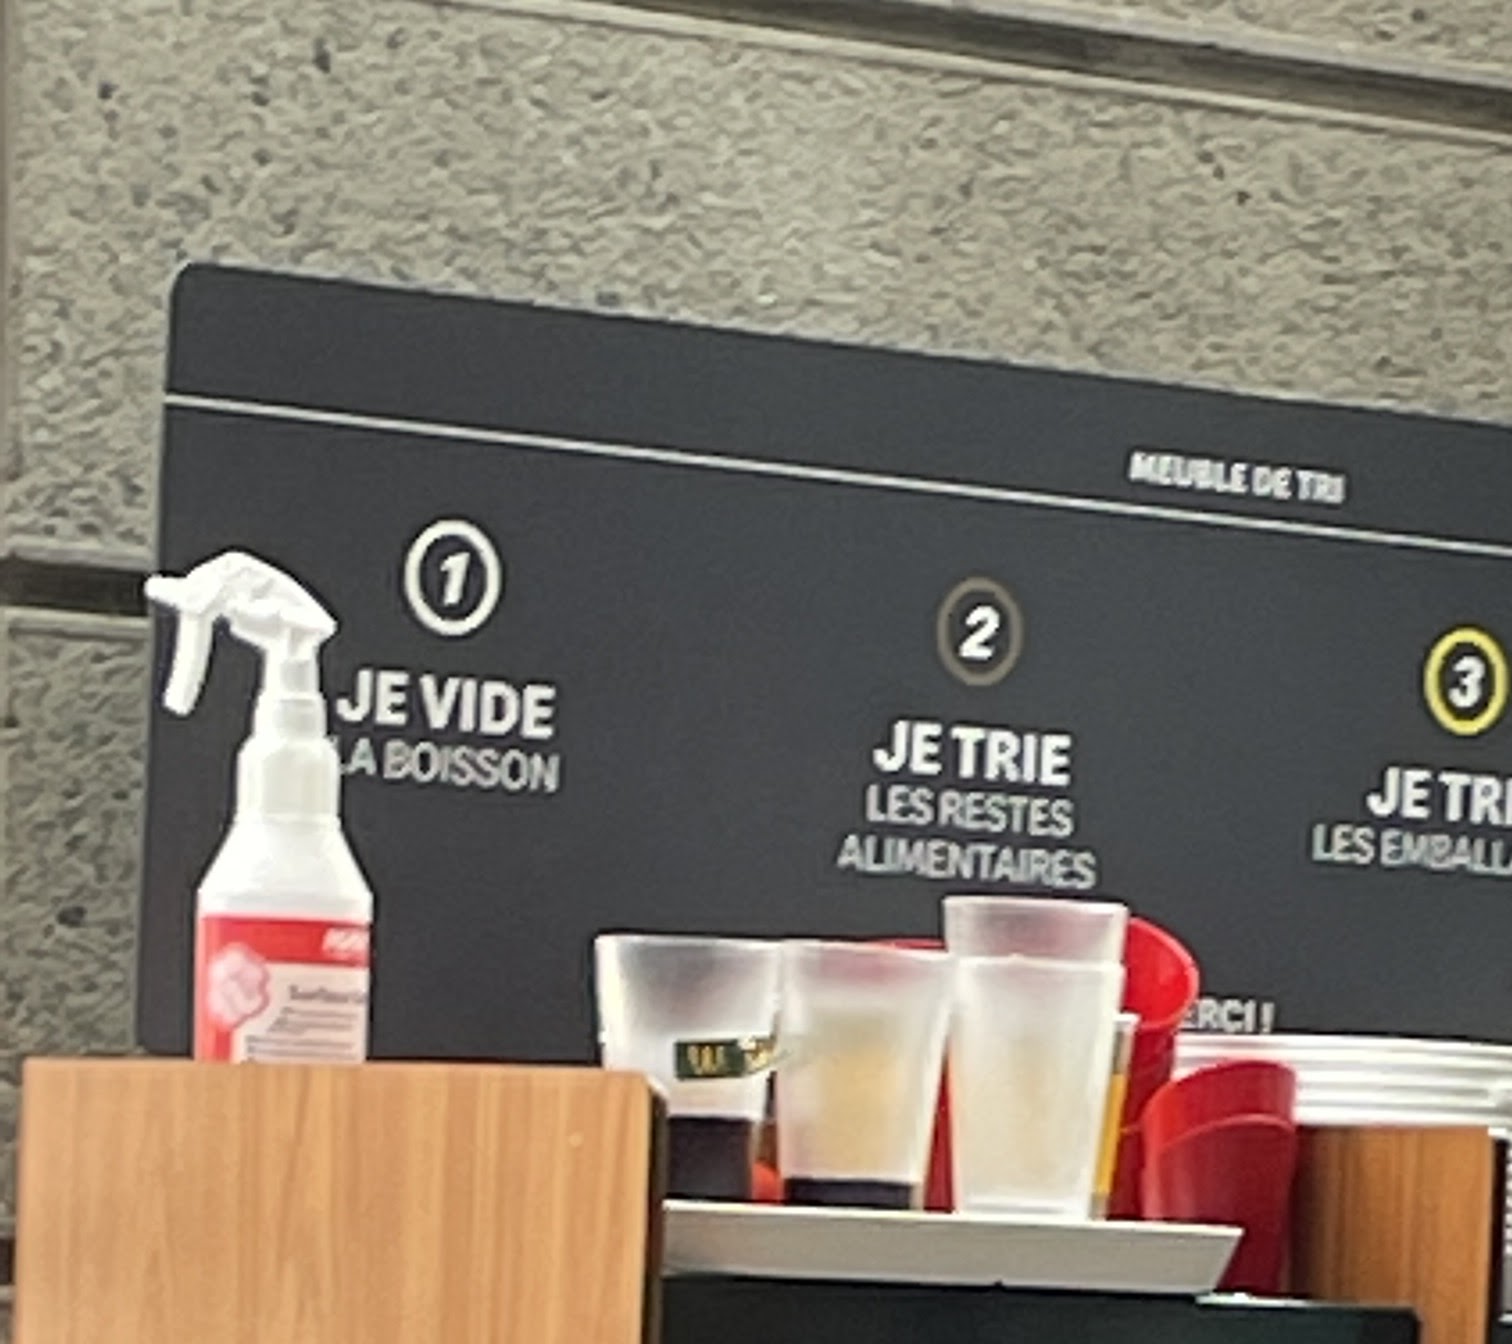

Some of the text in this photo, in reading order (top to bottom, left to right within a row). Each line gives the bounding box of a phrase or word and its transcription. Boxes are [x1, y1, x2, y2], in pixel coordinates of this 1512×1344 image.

[1128, 450, 1346, 504] MEUBLE DE TRI
[335, 668, 557, 741] JE VIDE
[384, 740, 561, 793] BOISSON
[872, 719, 1073, 787] JE TRIE
[865, 783, 1074, 839] LES RESTES
[1365, 765, 1433, 819] JE
[836, 833, 1097, 890] ALIMENTAIRES
[1311, 823, 1375, 865] LES
